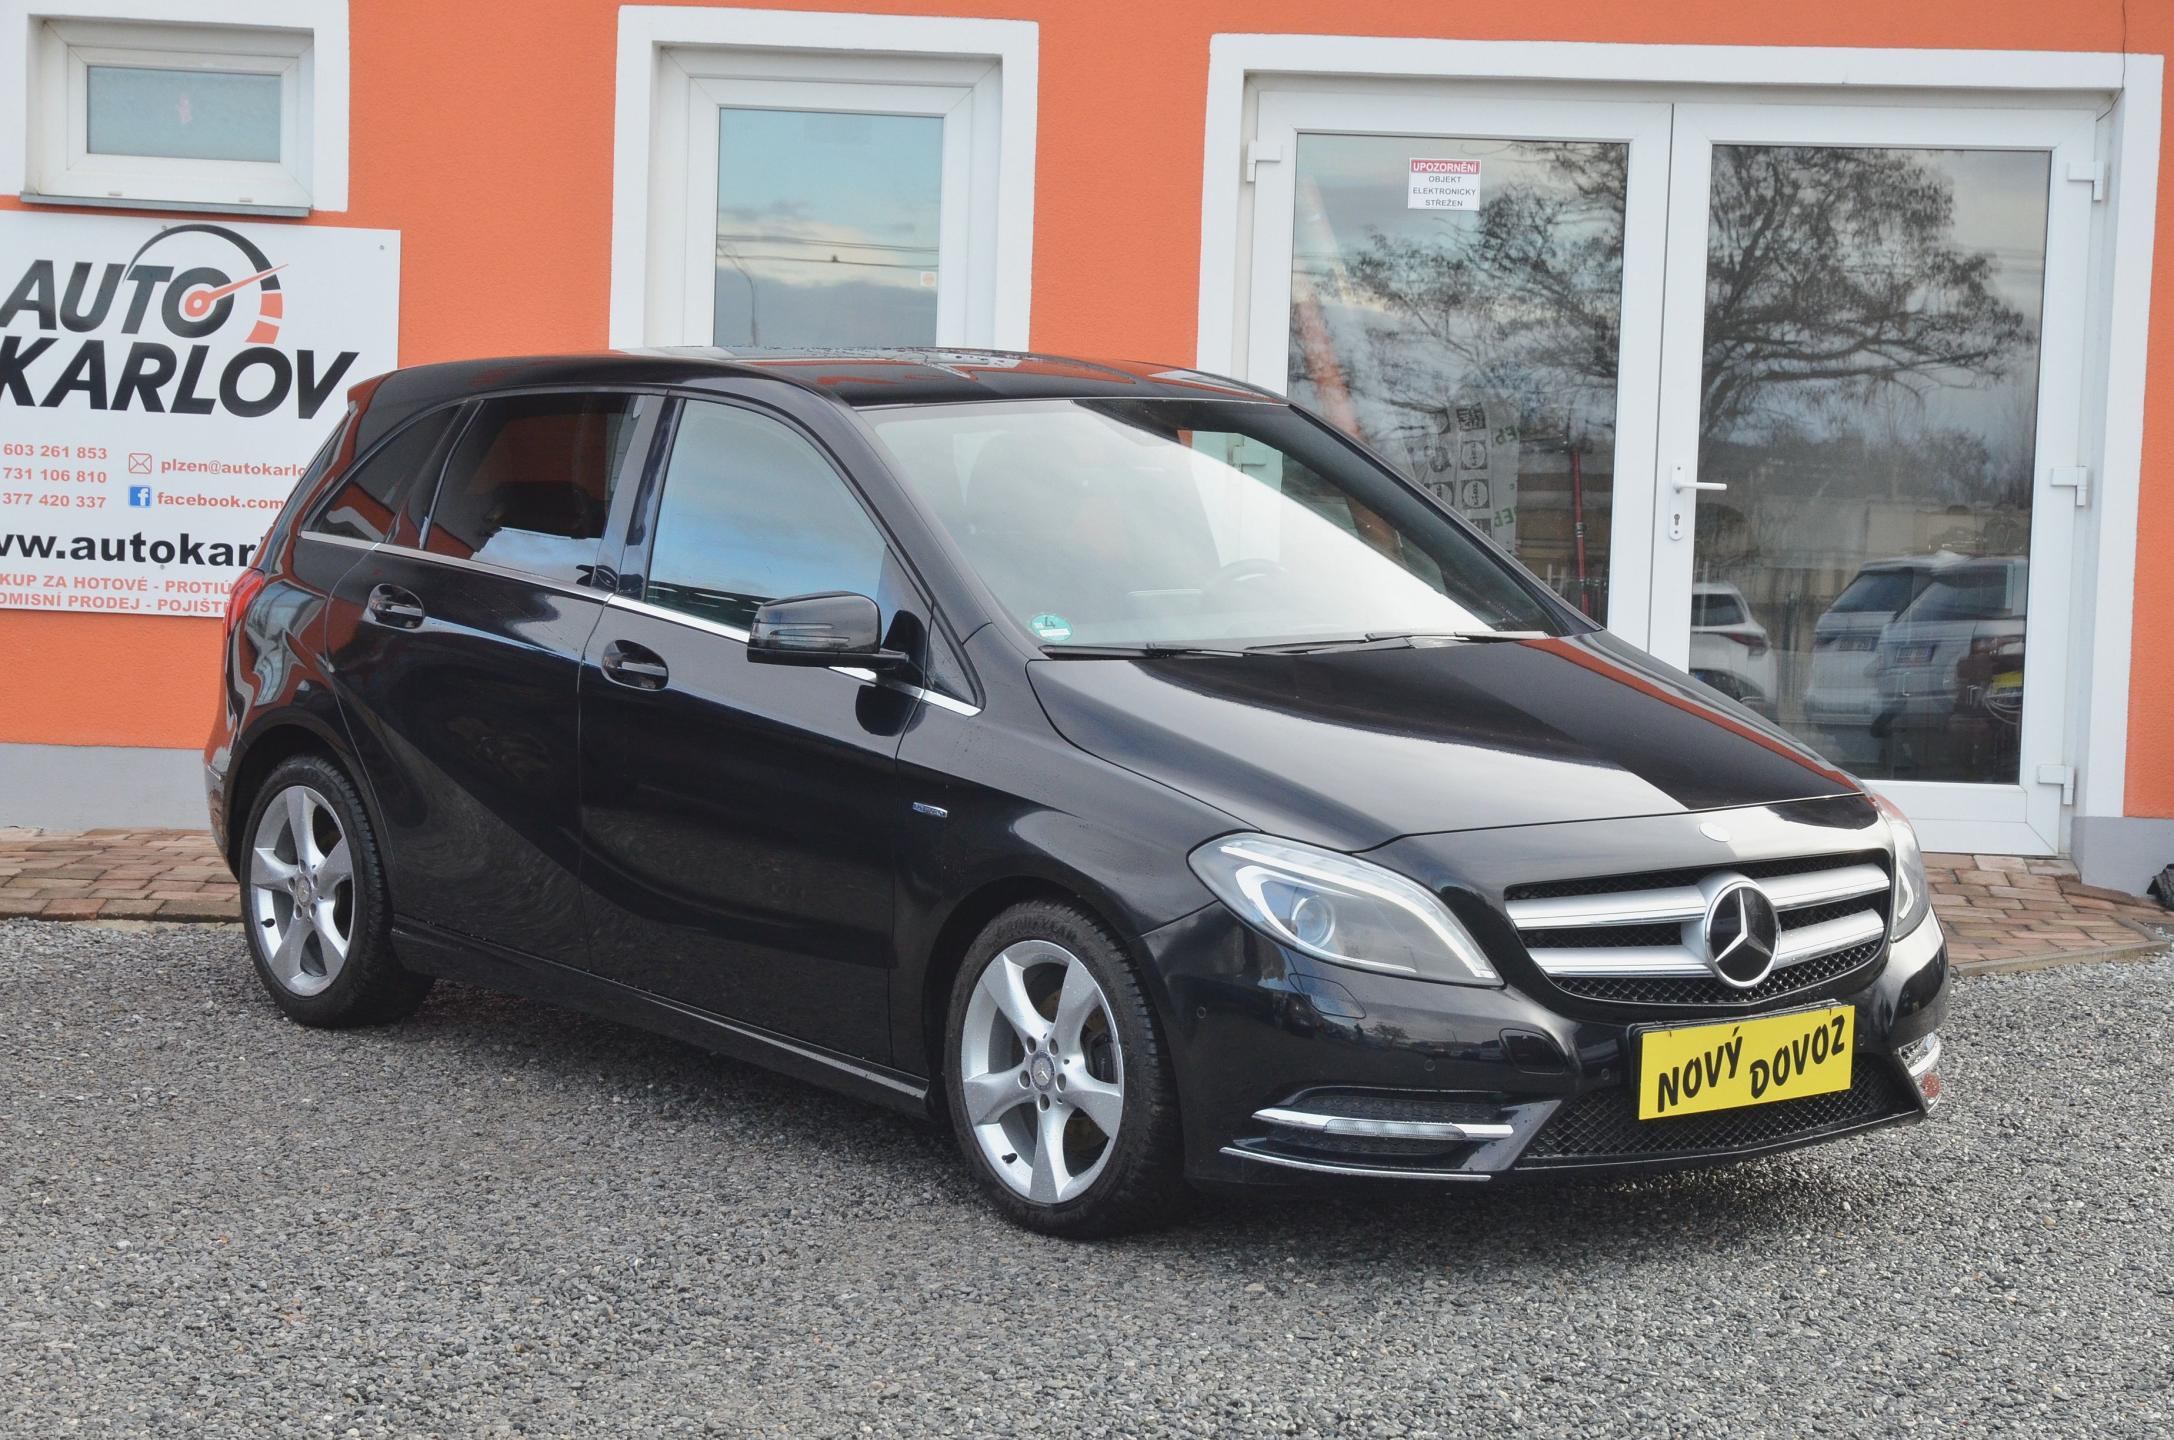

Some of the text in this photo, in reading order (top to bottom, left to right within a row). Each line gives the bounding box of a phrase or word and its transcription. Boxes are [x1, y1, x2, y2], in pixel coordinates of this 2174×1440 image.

[1413, 162, 1477, 173] UPOZORNĚNÍ
[1428, 175, 1462, 183] OBJEKT
[1412, 187, 1476, 196] ELEKTRONICKY
[0, 259, 235, 339] AUTO
[0, 335, 360, 420] KARLOV
[3, 443, 108, 460] 603 261 853
[3, 467, 107, 484] 731 106 810
[2, 492, 107, 508] 377 420 337
[157, 491, 285, 510] facebook.com
[0, 531, 264, 567] w.autokar
[0, 573, 38, 587] KUP
[43, 575, 68, 588] ZA
[73, 576, 149, 592] HOTOVÉ
[68, 594, 141, 610] PRODEJ
[1657, 1014, 1846, 1113] NOVÝ DOVOZ
